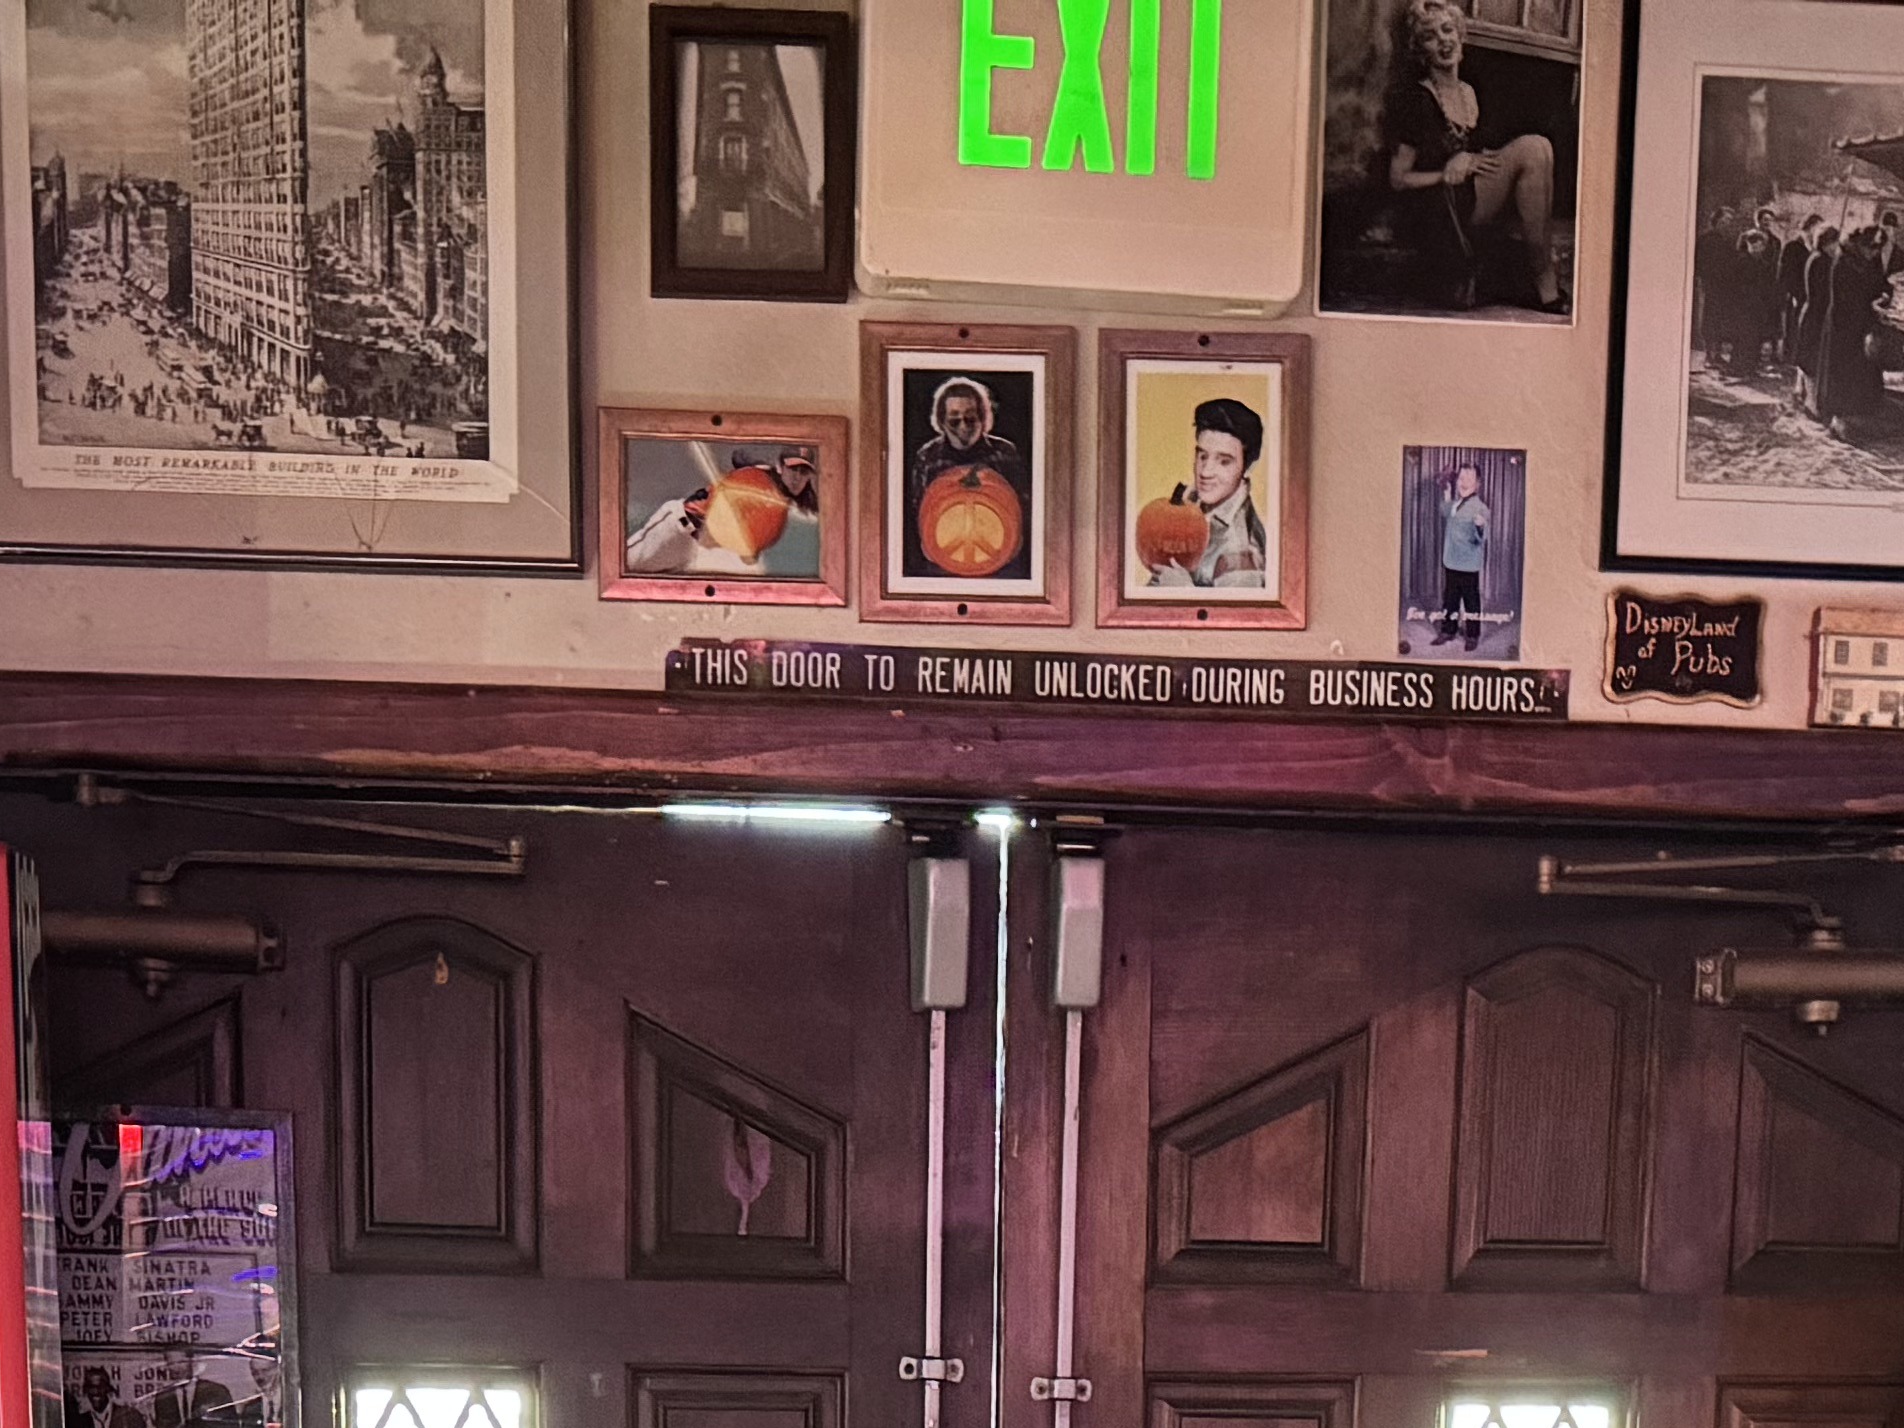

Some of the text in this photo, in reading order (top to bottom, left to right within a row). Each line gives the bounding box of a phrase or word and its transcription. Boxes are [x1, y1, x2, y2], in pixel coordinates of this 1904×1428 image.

[692, 648, 748, 686] THIS
[771, 651, 842, 689] DOOR
[864, 654, 896, 692] TO
[918, 656, 1013, 696] REMAIN
[1034, 661, 1171, 702] UNLOCKED
[1191, 665, 1286, 705] DURING
[1308, 668, 1435, 709] BUSINESS
[132, 1256, 212, 1275] SINATRA
[72, 1277, 195, 1292] DEAN MARTIN
[61, 1295, 114, 1310] AMMY
[138, 1296, 187, 1310] DAVIS
[61, 1312, 214, 1330] PETER LAWFORD
